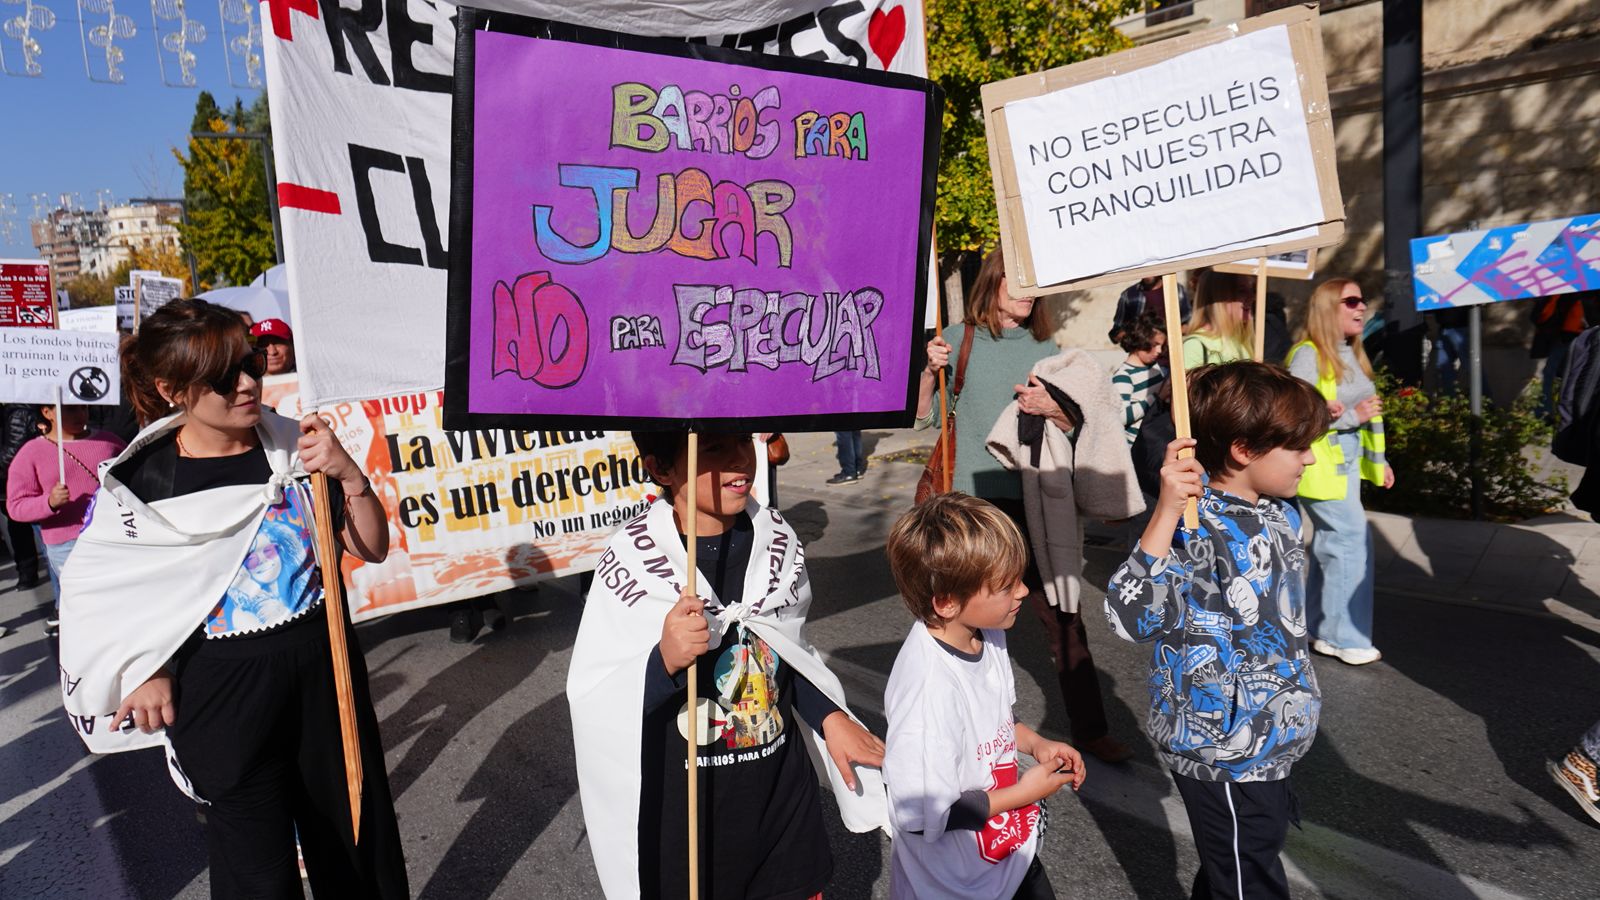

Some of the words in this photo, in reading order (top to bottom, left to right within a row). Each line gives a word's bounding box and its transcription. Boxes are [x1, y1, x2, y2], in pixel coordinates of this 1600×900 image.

[792, 110, 869, 161] PARA
[1029, 136, 1072, 166] NO
[1081, 76, 1280, 152] ESPECULÉIS
[1048, 158, 1113, 195] CON
[1122, 116, 1277, 176] NUESTRA
[347, 142, 449, 270] CL
[1049, 151, 1282, 229] TRANQUILIDAD
[531, 163, 795, 268] JUGAR
[4, 333, 26, 344] Los
[31, 335, 72, 347] fondos
[76, 337, 116, 349] buitres
[491, 271, 589, 389] NO
[610, 315, 666, 352] PARA
[670, 284, 884, 383] ESPECULAR
[2, 350, 54, 361] arruinan
[59, 351, 69, 361] la
[73, 352, 98, 363] vida
[102, 353, 116, 363] de
[5, 364, 16, 375] la
[22, 367, 60, 379] gente
[385, 433, 435, 473] La
[445, 430, 605, 463] vivienda
[399, 493, 439, 528] es
[449, 482, 500, 519] un
[511, 454, 652, 508] derecho
[533, 520, 556, 540] No
[562, 515, 585, 535] un
[1243, 673, 1285, 686] SONIC
[1247, 683, 1280, 691] SPEED
[737, 751, 770, 762] PARA
